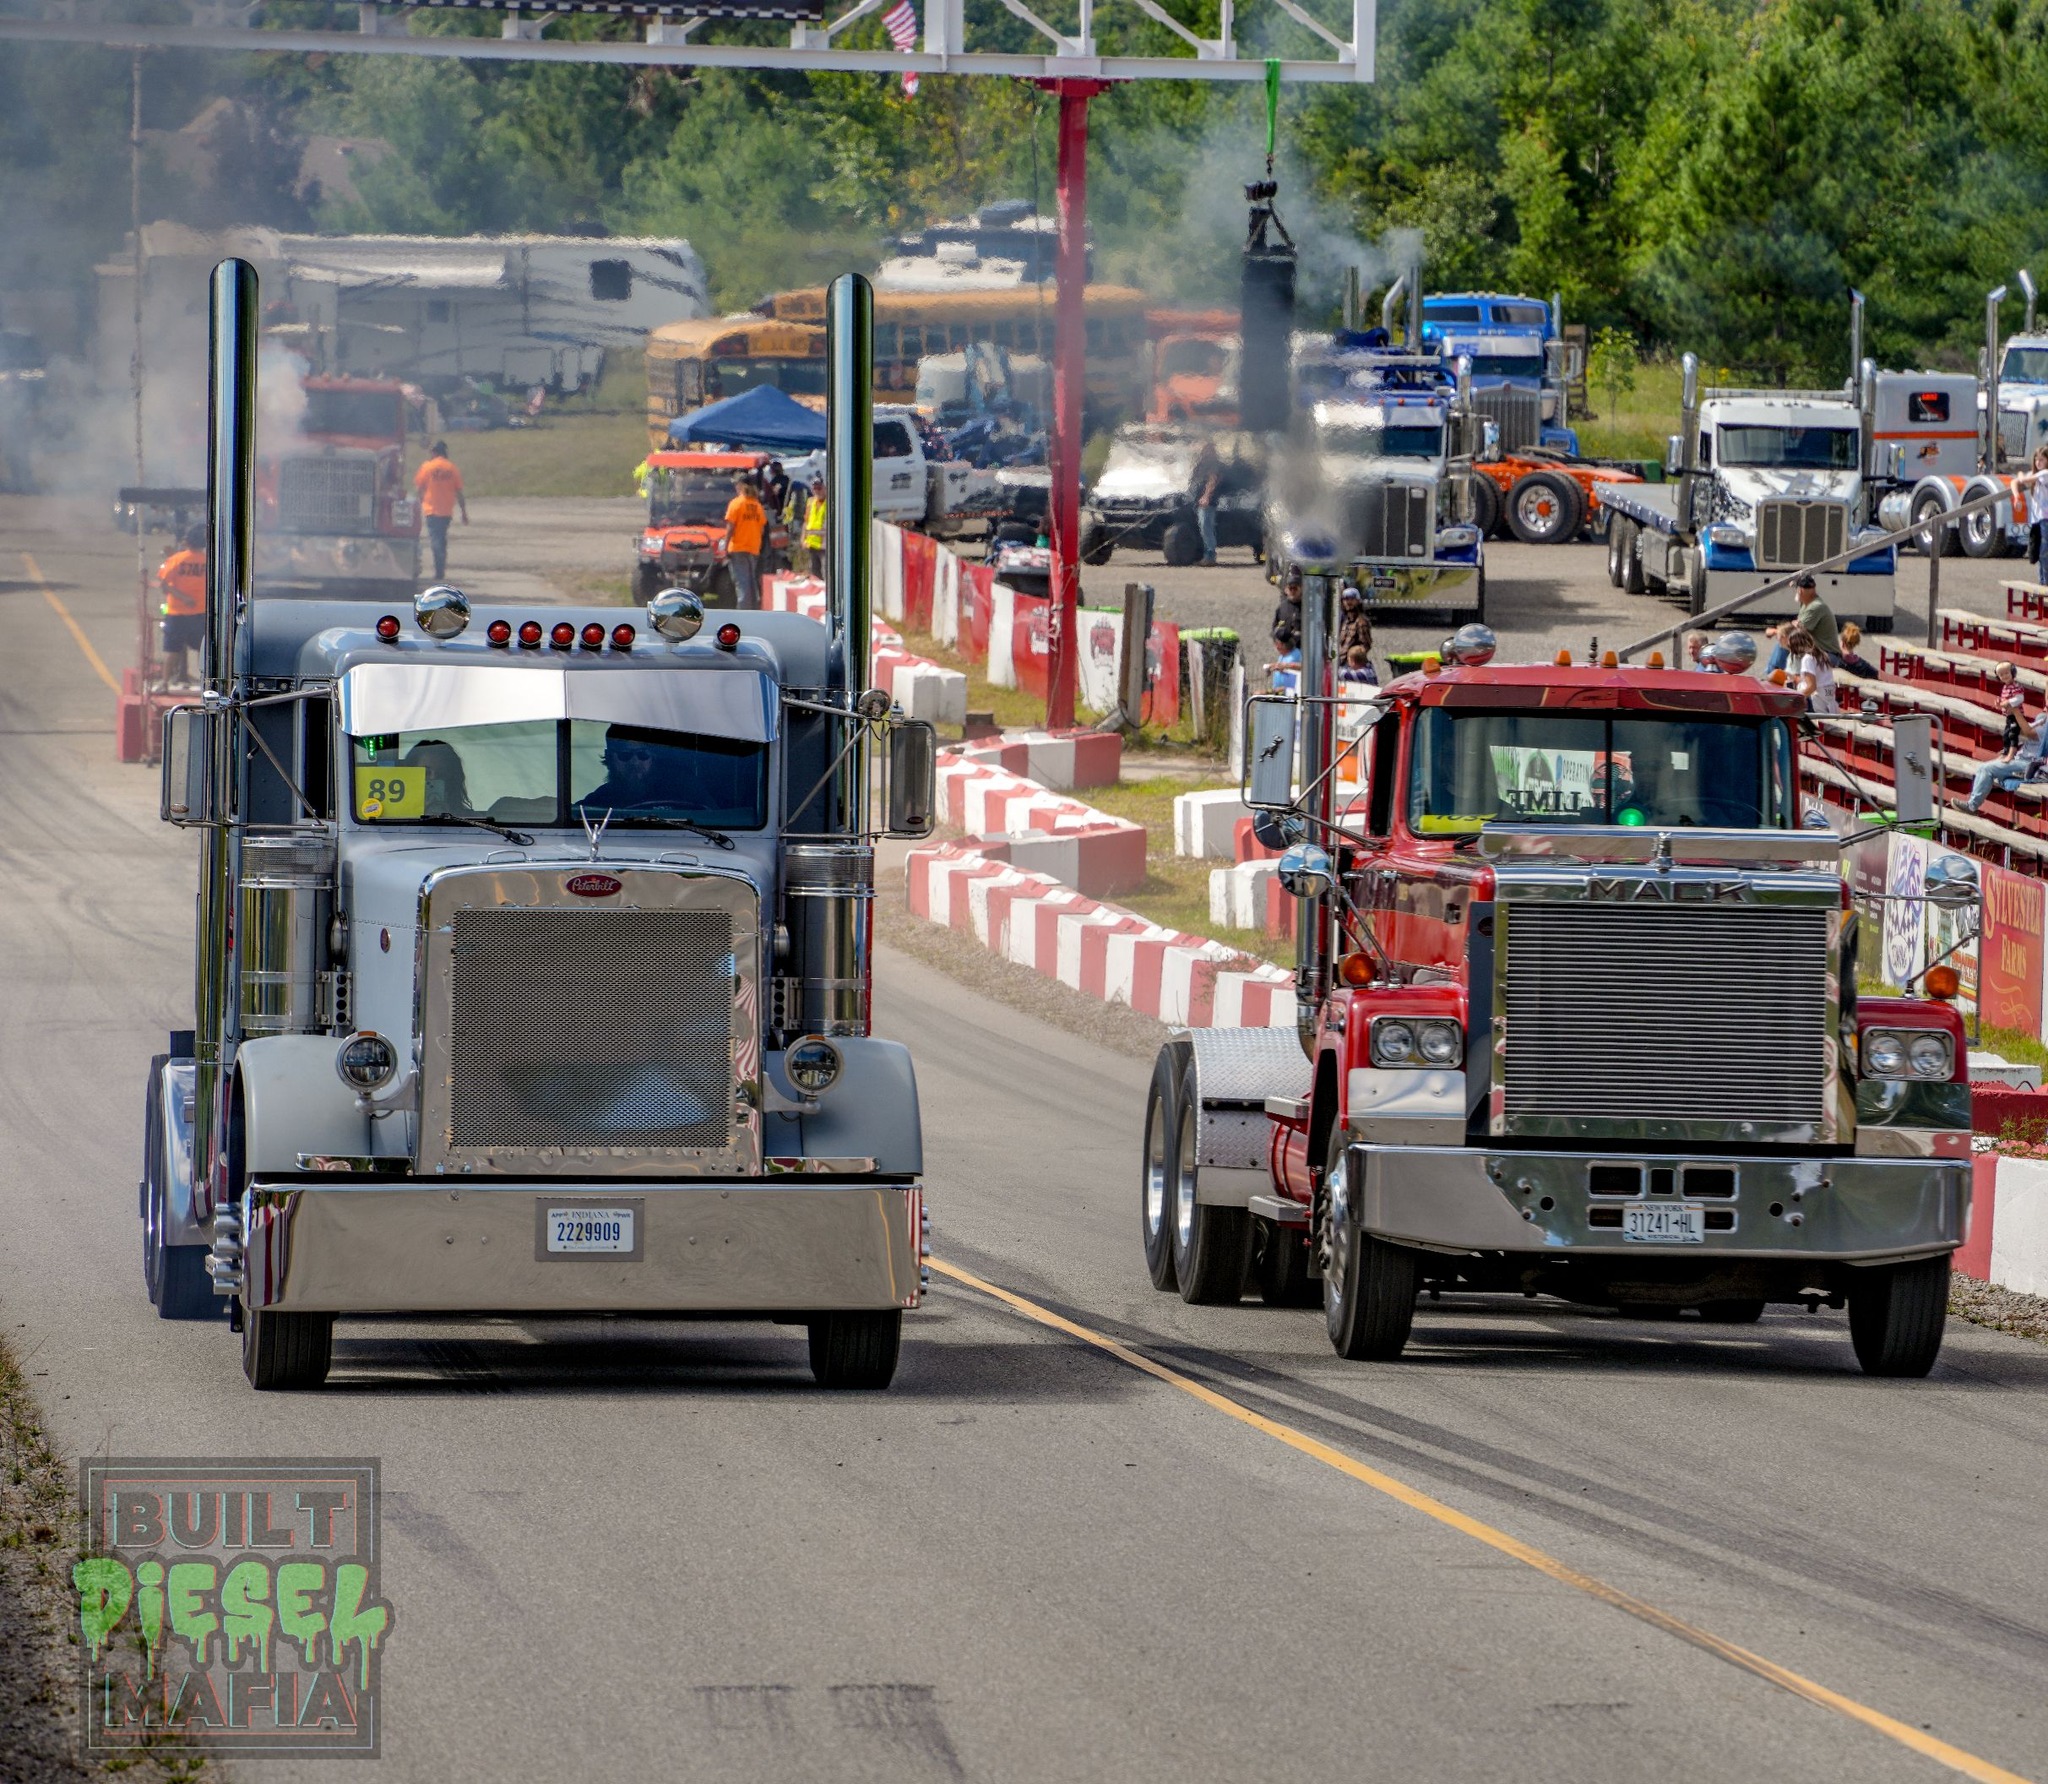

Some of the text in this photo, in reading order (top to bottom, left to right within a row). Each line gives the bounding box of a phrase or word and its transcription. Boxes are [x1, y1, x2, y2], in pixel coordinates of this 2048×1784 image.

[367, 779, 406, 803] 89
[573, 878, 618, 892] Peterbilt
[1587, 877, 1752, 903] MACK
[1985, 868, 2042, 940] SYLVESTER
[2001, 933, 2027, 980] FARMS
[571, 1211, 611, 1219] INDIANA
[557, 1222, 621, 1242] 2229909
